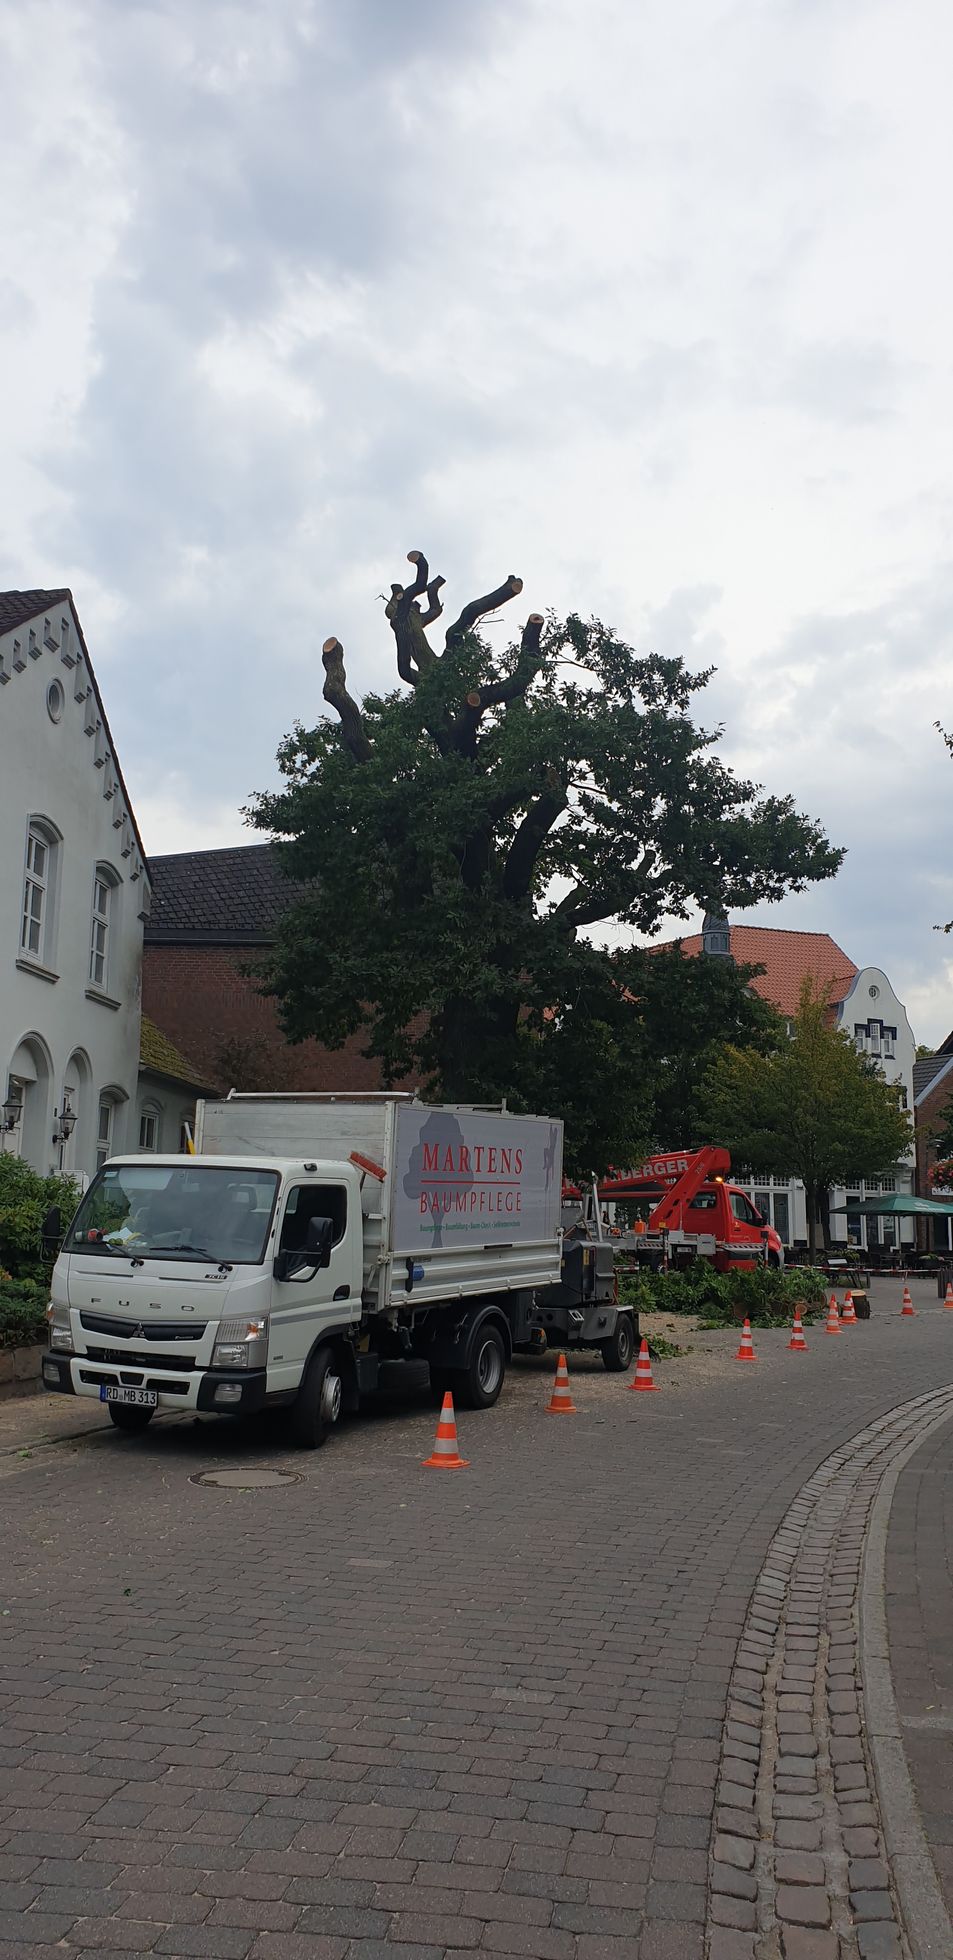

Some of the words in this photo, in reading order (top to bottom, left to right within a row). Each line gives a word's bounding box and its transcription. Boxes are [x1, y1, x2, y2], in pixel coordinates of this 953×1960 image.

[421, 1143, 523, 1175] MARTENS
[419, 1191, 522, 1214] BAUMPFLEGE
[91, 1297, 195, 1312] FUSO
[138, 1391, 156, 1405] 313
